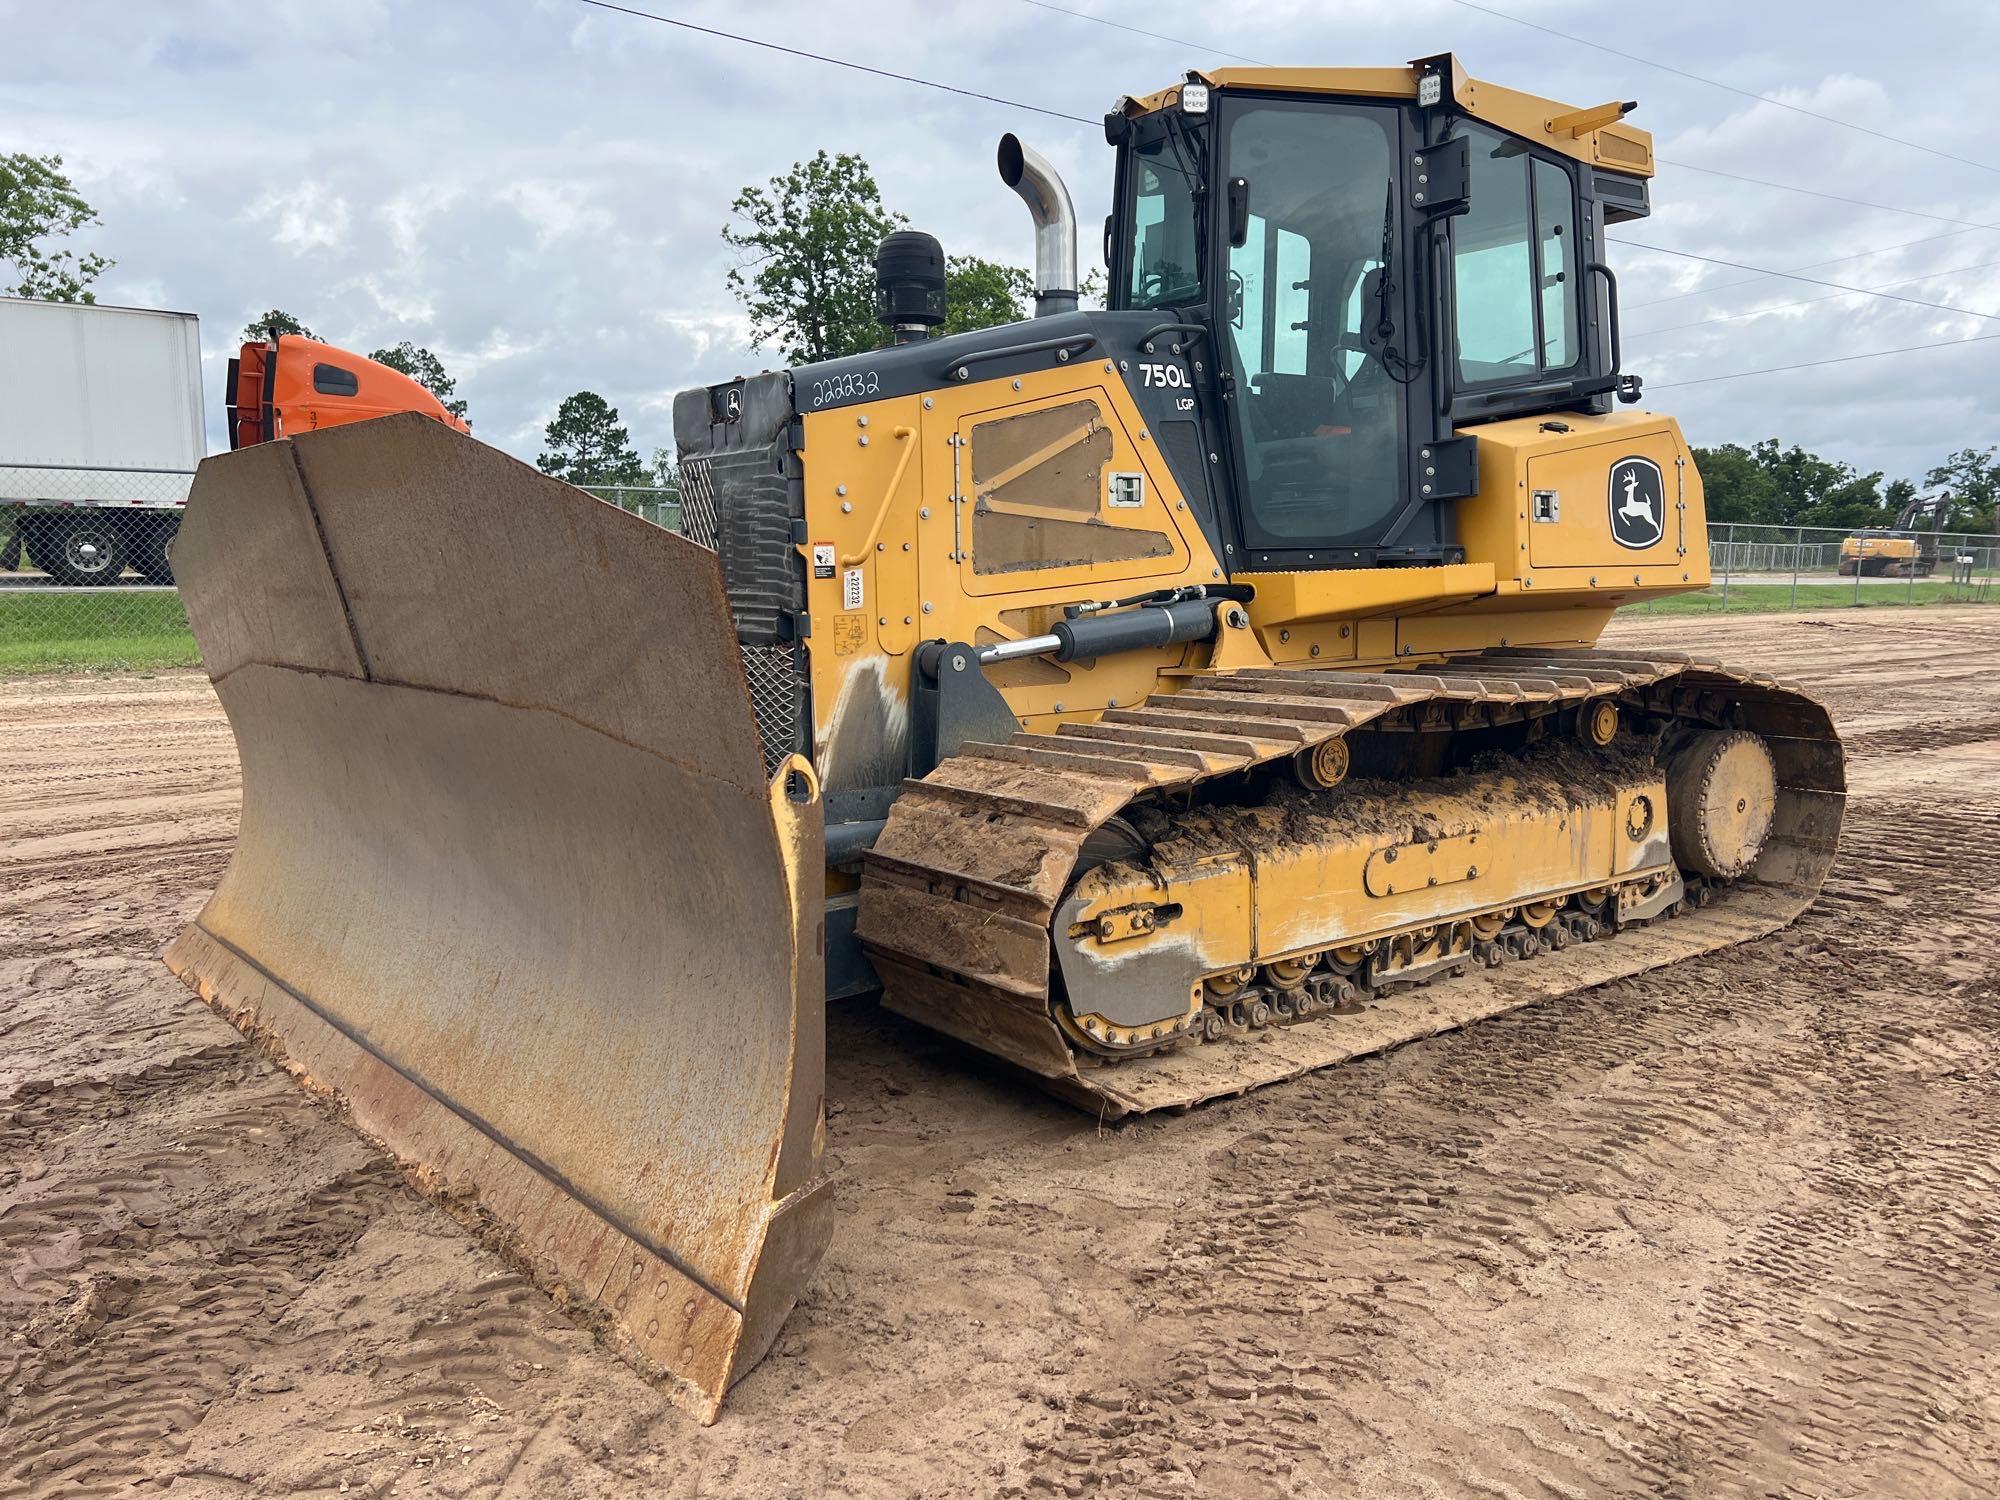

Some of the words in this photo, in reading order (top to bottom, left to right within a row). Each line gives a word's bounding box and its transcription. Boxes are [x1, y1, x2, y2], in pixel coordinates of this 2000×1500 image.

[1139, 364, 1191, 388] 750L
[813, 371, 880, 407] 222232
[1176, 399, 1194, 410] LGP
[851, 577, 860, 604] 222232
